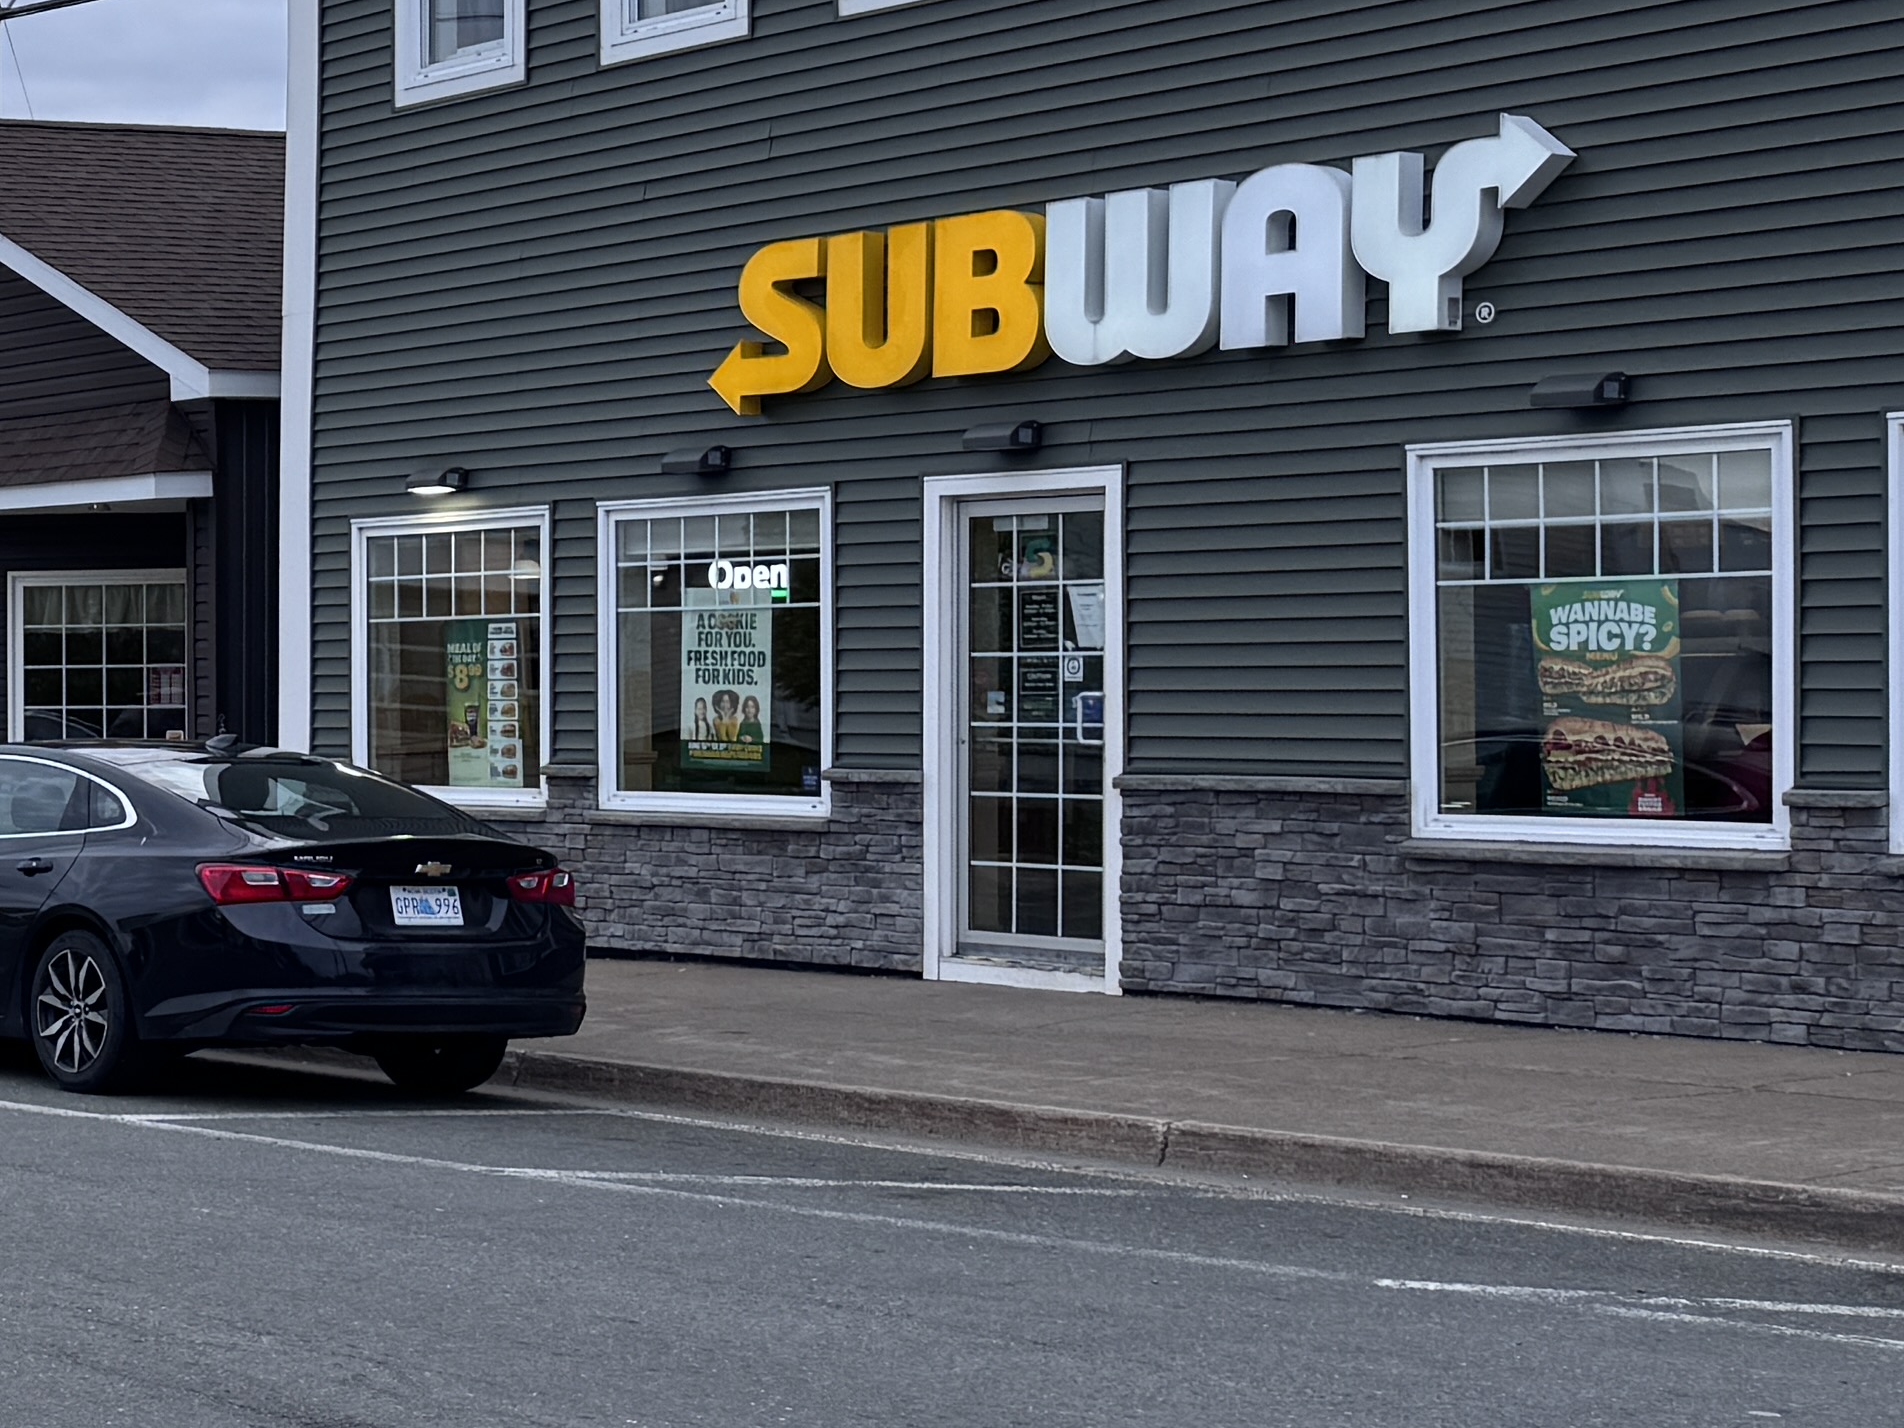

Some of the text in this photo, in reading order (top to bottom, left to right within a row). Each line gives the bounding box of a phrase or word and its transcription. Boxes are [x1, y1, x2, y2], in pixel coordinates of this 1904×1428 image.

[707, 113, 1577, 416] SUBWAY
[708, 561, 787, 589] Open
[696, 613, 706, 630] A
[1549, 600, 1657, 624] WANNABE
[698, 632, 755, 647] FOR YOU.
[1549, 622, 1657, 651] SPICY?
[687, 650, 766, 667] FRESH FOOD
[695, 668, 758, 686] FOR KIDS.
[395, 897, 460, 916] GPR 996
